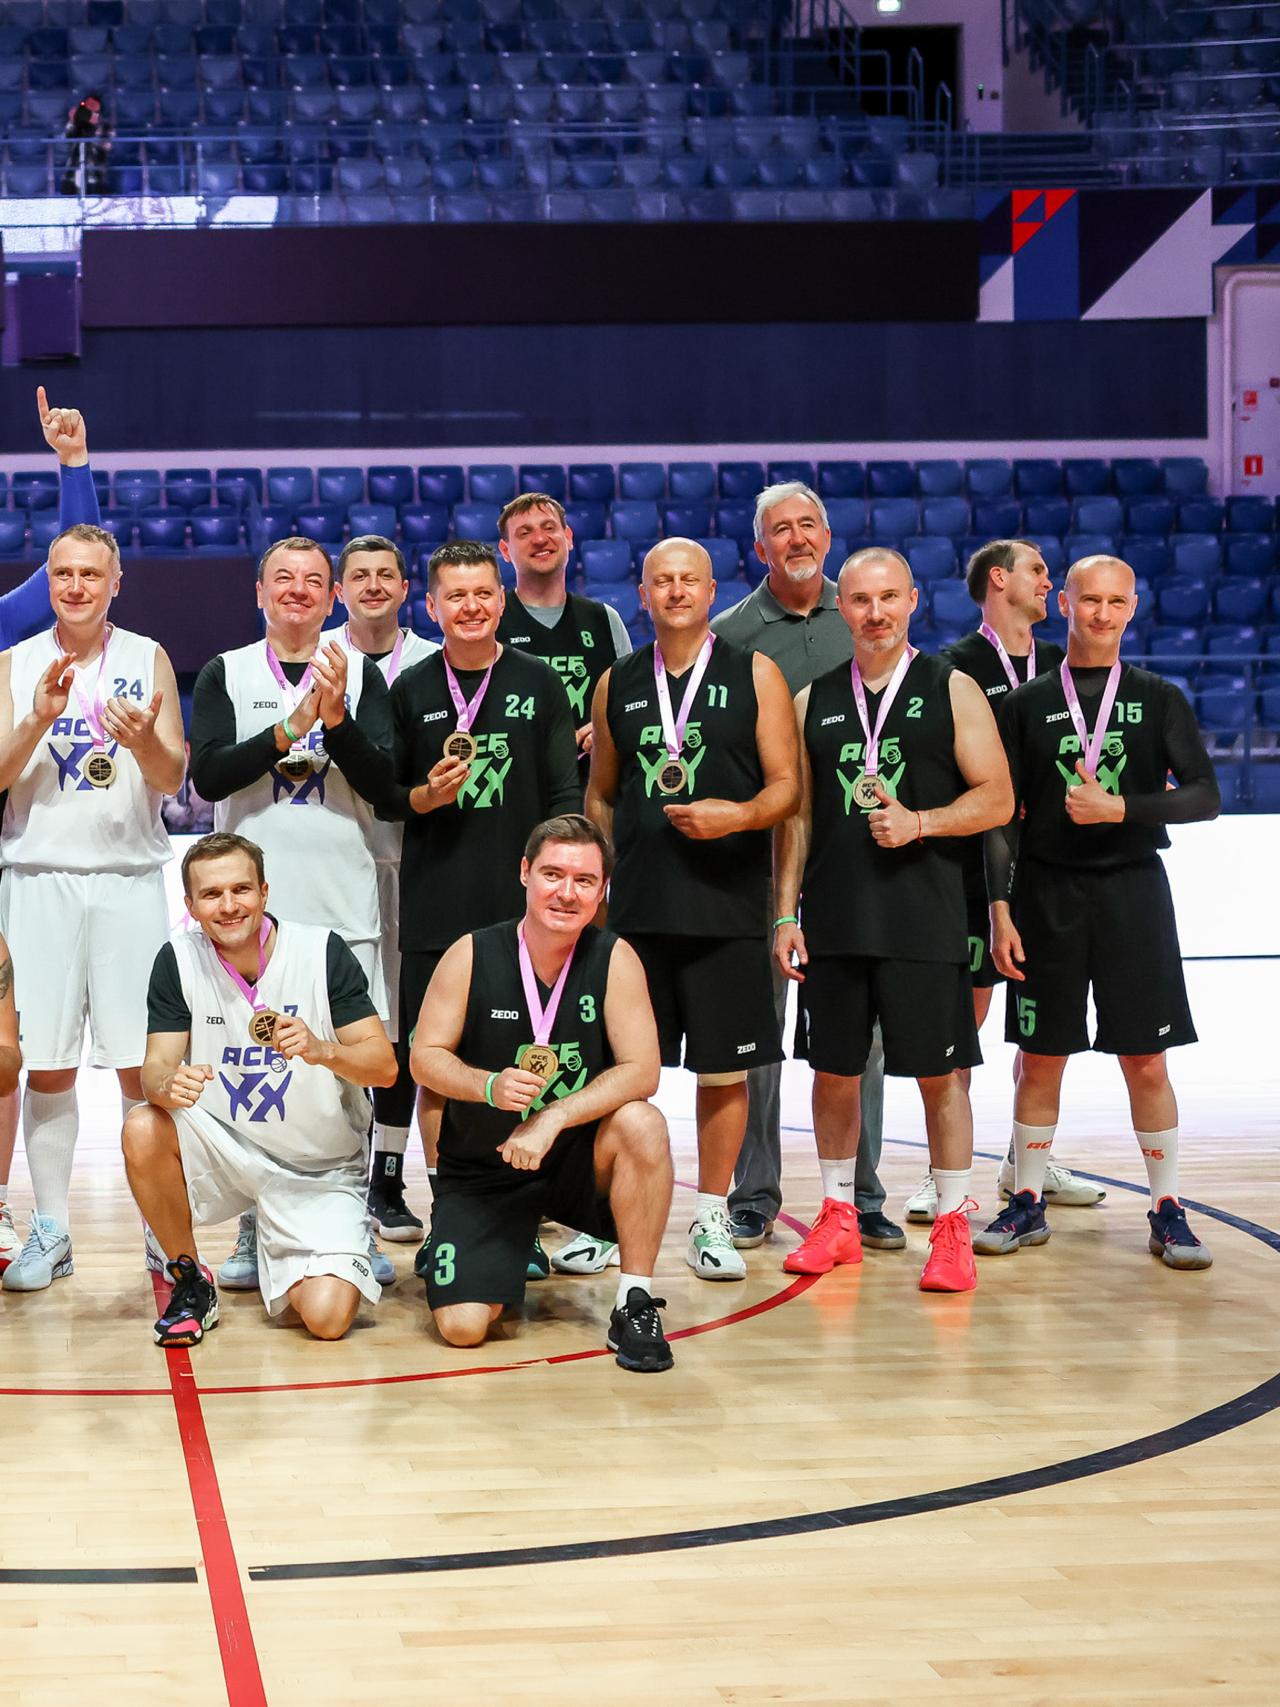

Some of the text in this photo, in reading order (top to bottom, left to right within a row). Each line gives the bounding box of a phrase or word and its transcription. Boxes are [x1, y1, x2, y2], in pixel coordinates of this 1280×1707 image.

[580, 630, 594, 648] 8
[537, 656, 587, 678] СБ
[113, 678, 144, 701] 24
[707, 684, 728, 709] 11
[986, 684, 1008, 697] ZEDO
[253, 701, 278, 709] ZEDO
[505, 694, 536, 720] 24
[624, 700, 649, 712] ZEDO
[906, 697, 924, 719] 2
[1115, 701, 1143, 724] 15
[423, 710, 448, 723] ZEDO
[821, 714, 845, 726] ZEDO
[1046, 711, 1070, 723] ZEDO
[474, 732, 510, 760] СБ
[490, 1009, 519, 1020] ZEDO
[579, 994, 596, 1023] 3
[737, 1042, 757, 1054] ZEDO
[352, 1258, 370, 1278] ZEDO
[435, 1242, 456, 1286] 3
